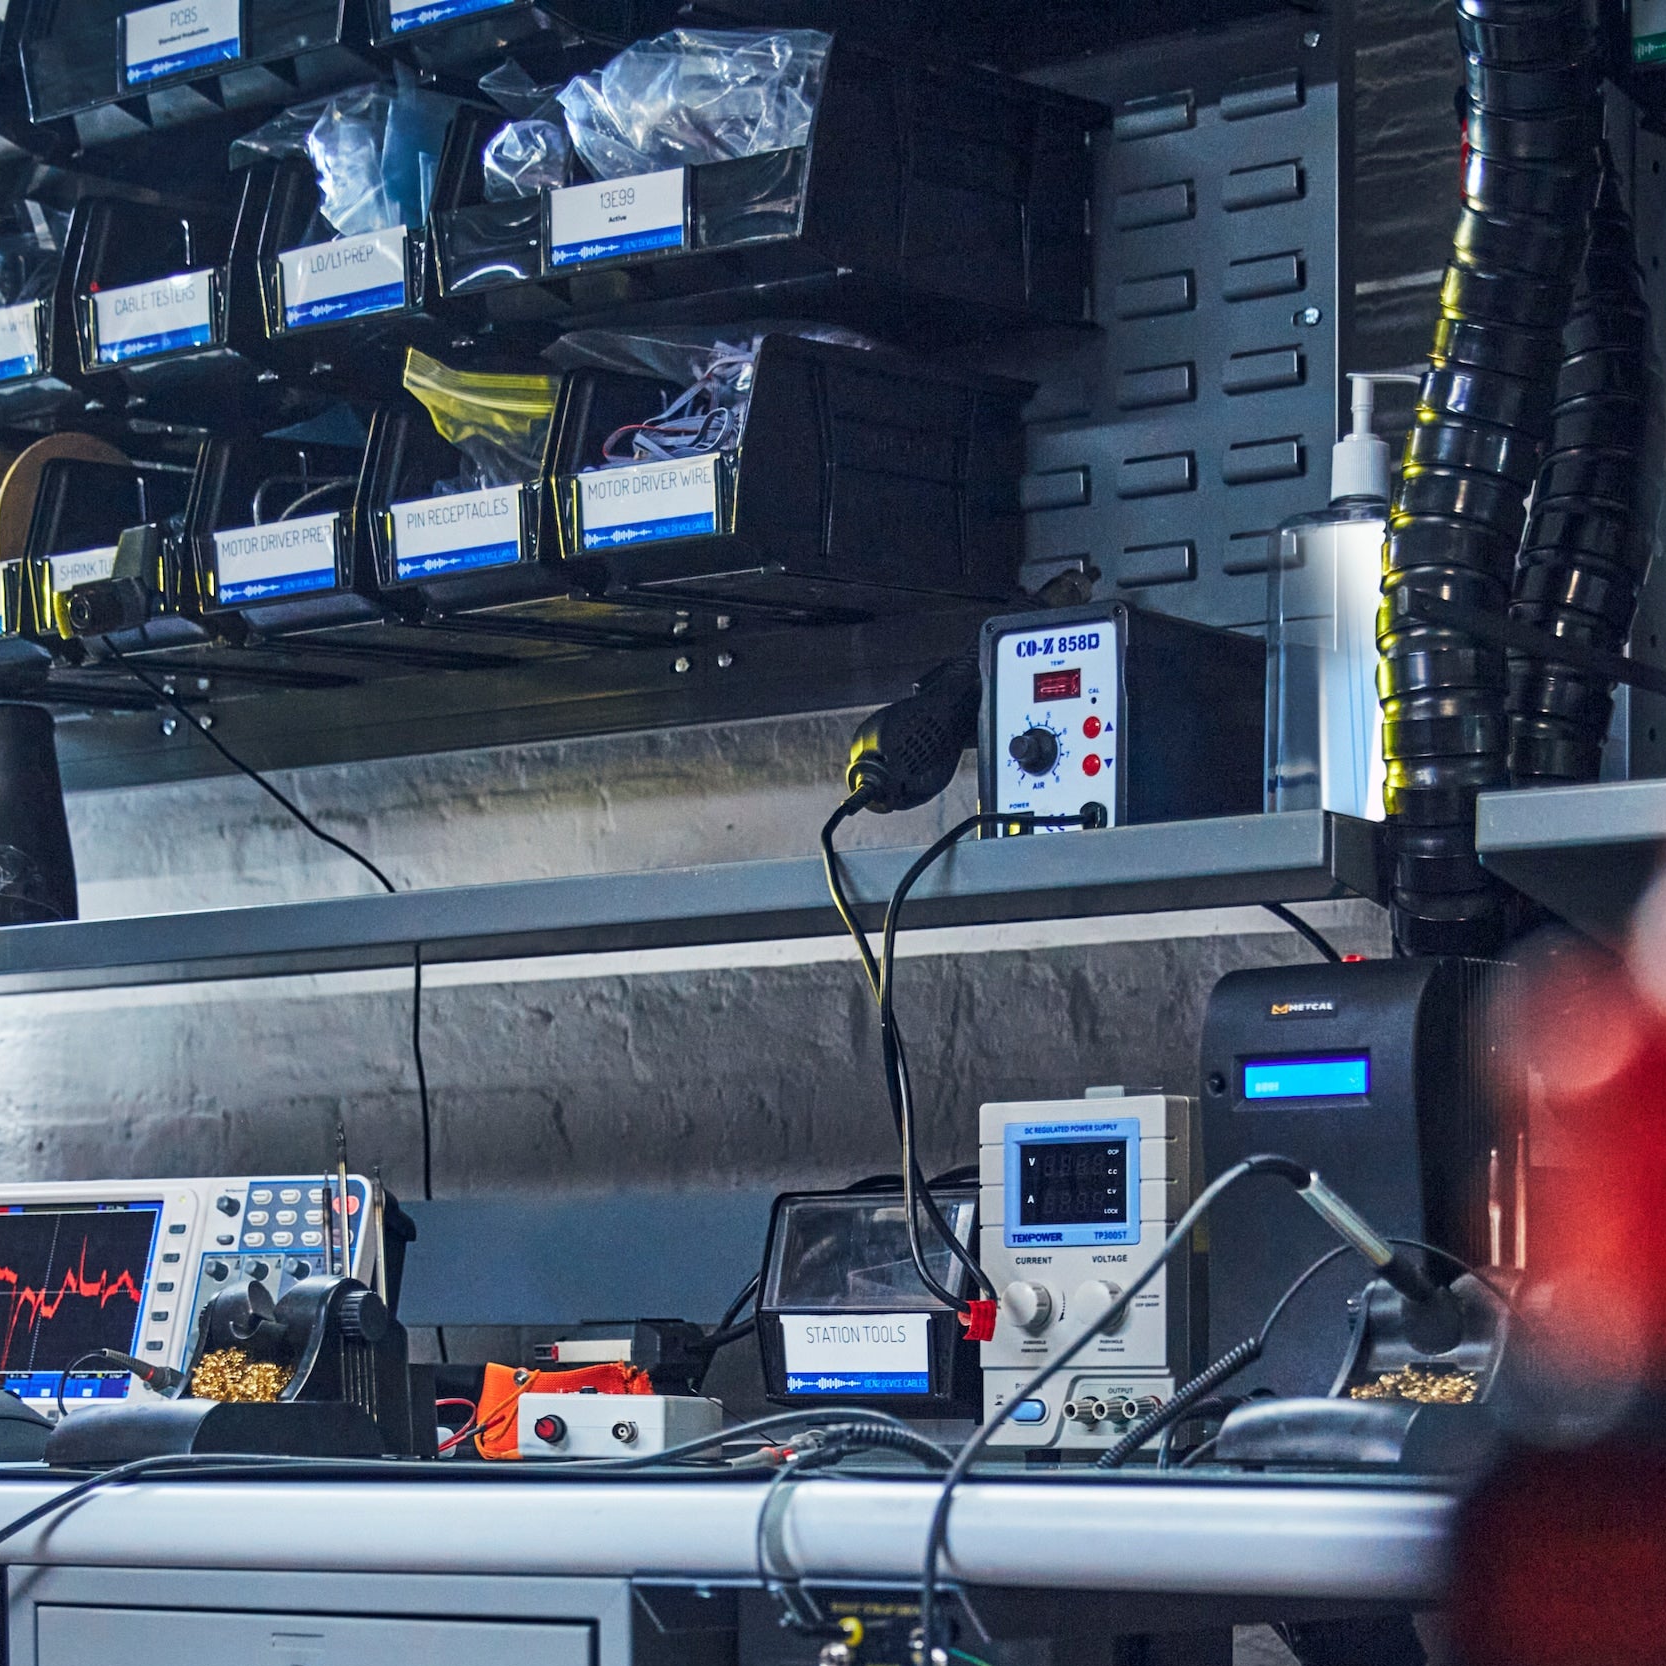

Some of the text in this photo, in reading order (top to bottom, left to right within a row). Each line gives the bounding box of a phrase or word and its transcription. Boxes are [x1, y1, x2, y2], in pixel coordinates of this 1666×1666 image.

[170, 6, 198, 27] PCBS
[600, 187, 635, 209] 13E99
[608, 215, 627, 223] Active
[344, 244, 374, 265] PREP
[114, 283, 196, 316] CABLE TESTERS
[588, 465, 712, 501] MOTOR DRIVER WIRE
[406, 498, 509, 529] PIN RECEPTACLES
[221, 524, 333, 558] MOTOR DRIVER PREP
[60, 564, 97, 582] SHRINK
[1016, 633, 1100, 658] CO-Z 858D
[1062, 727, 1068, 735] 6
[1032, 782, 1045, 790] AIR
[1289, 1002, 1333, 1012] METCAL
[1024, 1127, 1034, 1135] DC
[1034, 1126, 1070, 1134] REGULATED
[1093, 1124, 1118, 1132] SUPPLY
[1028, 1157, 1036, 1167] V
[1027, 1194, 1035, 1204] A
[1094, 1231, 1128, 1240] TP3005T
[1015, 1254, 1128, 1265] CURRENT VOLTAGE
[806, 1325, 906, 1344] STATION TOOLS
[903, 1378, 928, 1388] CABLES
[1108, 1387, 1134, 1395] OUTPUT
